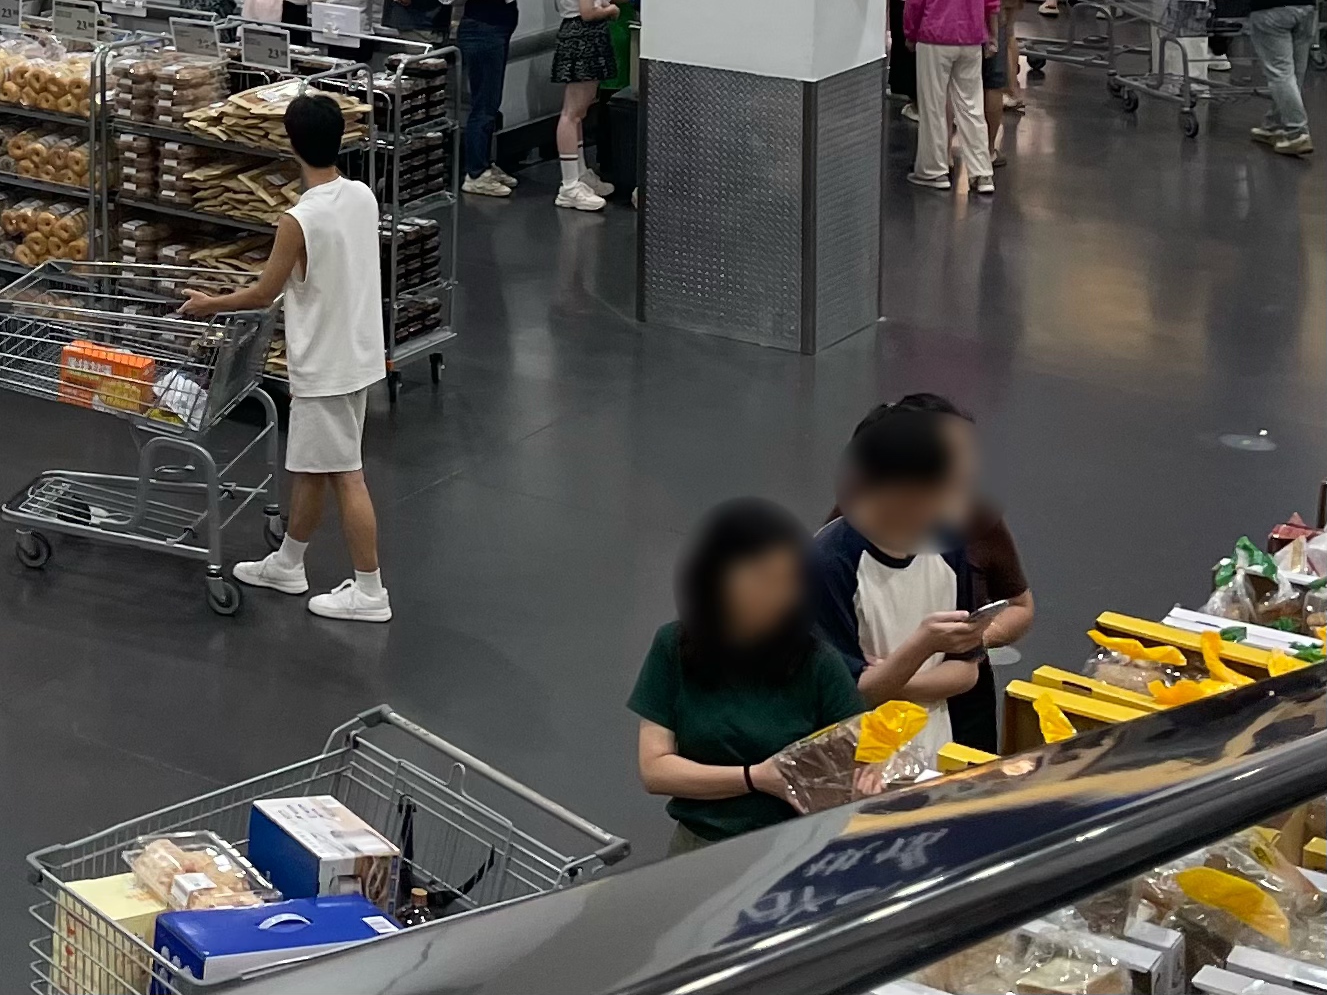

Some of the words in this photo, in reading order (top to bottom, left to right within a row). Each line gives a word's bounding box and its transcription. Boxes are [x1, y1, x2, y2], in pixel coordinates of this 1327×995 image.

[1, 7, 12, 18] 23
[76, 19, 88, 30] 23
[268, 48, 280, 59] 23
